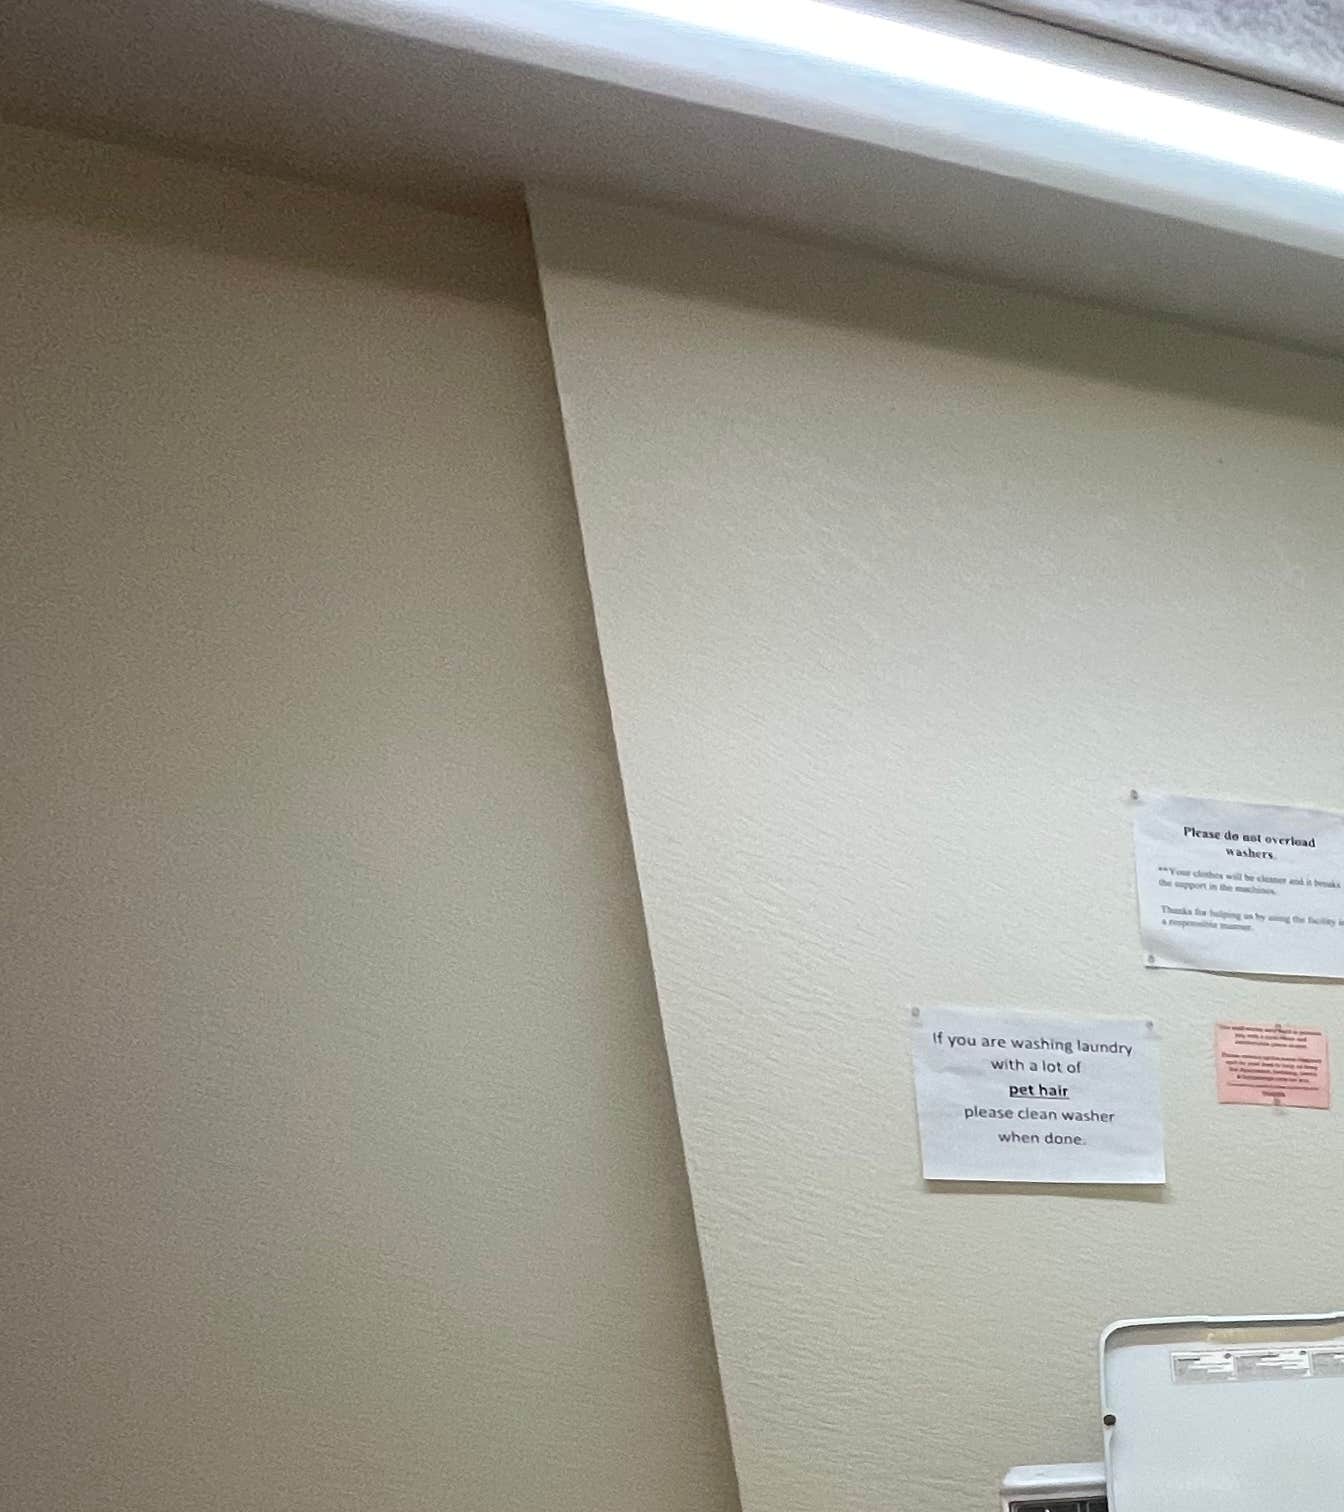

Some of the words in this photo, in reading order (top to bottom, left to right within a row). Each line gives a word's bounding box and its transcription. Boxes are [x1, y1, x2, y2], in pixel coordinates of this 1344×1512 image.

[1183, 826, 1220, 840] Please
[1224, 830, 1239, 841] do
[1242, 833, 1262, 843] not
[1264, 836, 1316, 848] overload
[1226, 847, 1276, 860] washers.
[1158, 879, 1172, 887] the
[1219, 884, 1233, 892] the
[1226, 873, 1242, 881] will
[1244, 873, 1255, 882] be
[1289, 877, 1304, 886] and
[1306, 878, 1312, 887] it
[1160, 905, 1192, 915] Thanks
[1194, 907, 1207, 916] for
[1254, 912, 1266, 921] by
[1292, 915, 1306, 924] the
[933, 1031, 943, 1044] If
[948, 1036, 977, 1048] you
[981, 1037, 1006, 1048] are
[1011, 1037, 1073, 1054] washing
[1077, 1039, 1133, 1057] laundry
[991, 1059, 1025, 1071] with
[1029, 1062, 1038, 1071] a
[1042, 1060, 1063, 1073] lot
[1066, 1061, 1081, 1074] of
[1008, 1085, 1034, 1098] pet
[1039, 1084, 1069, 1098] hair
[964, 1106, 1014, 1119] please
[1017, 1107, 1057, 1120] clean
[1061, 1109, 1115, 1123] washer
[998, 1130, 1040, 1144] when
[1044, 1132, 1087, 1145] done.
